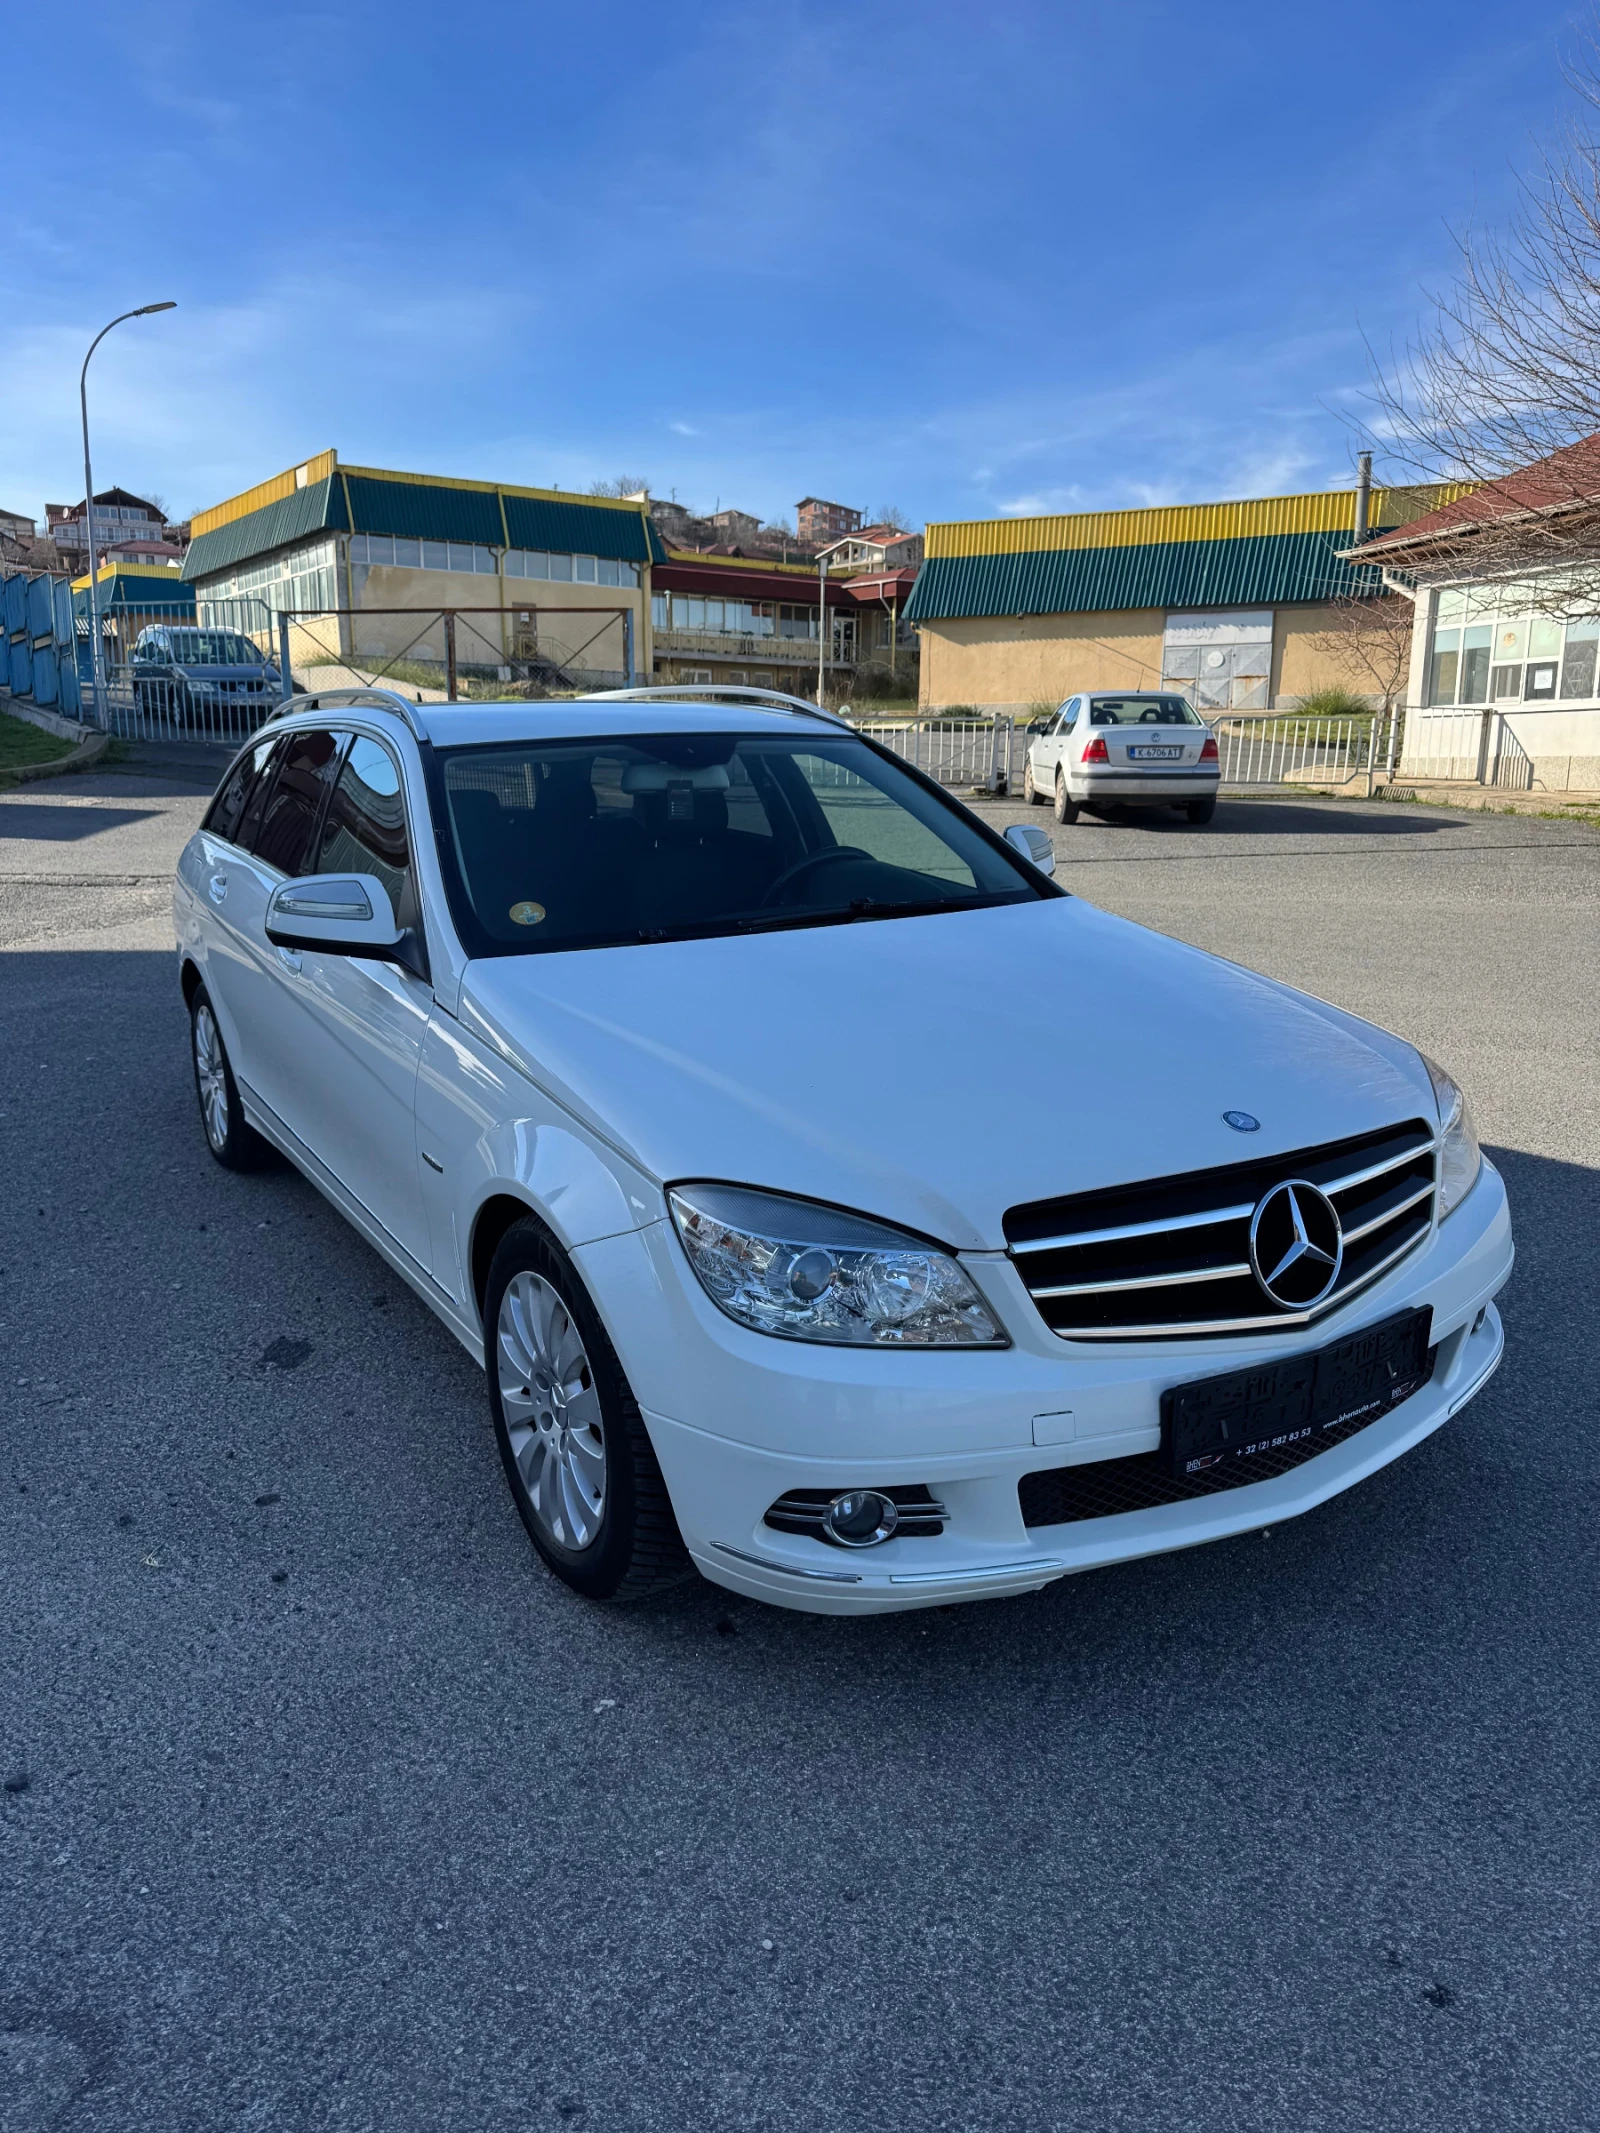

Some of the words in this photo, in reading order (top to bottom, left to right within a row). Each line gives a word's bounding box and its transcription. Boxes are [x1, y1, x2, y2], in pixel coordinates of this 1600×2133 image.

[1138, 748, 1144, 757] K
[1146, 749, 1166, 757] 6706
[1168, 748, 1178, 757] AT
[1244, 1444, 1257, 1455] 32
[1258, 1440, 1270, 1451] (2)
[1271, 1435, 1287, 1446] 582
[1288, 1431, 1300, 1441] 83
[1300, 1427, 1312, 1438] 53
